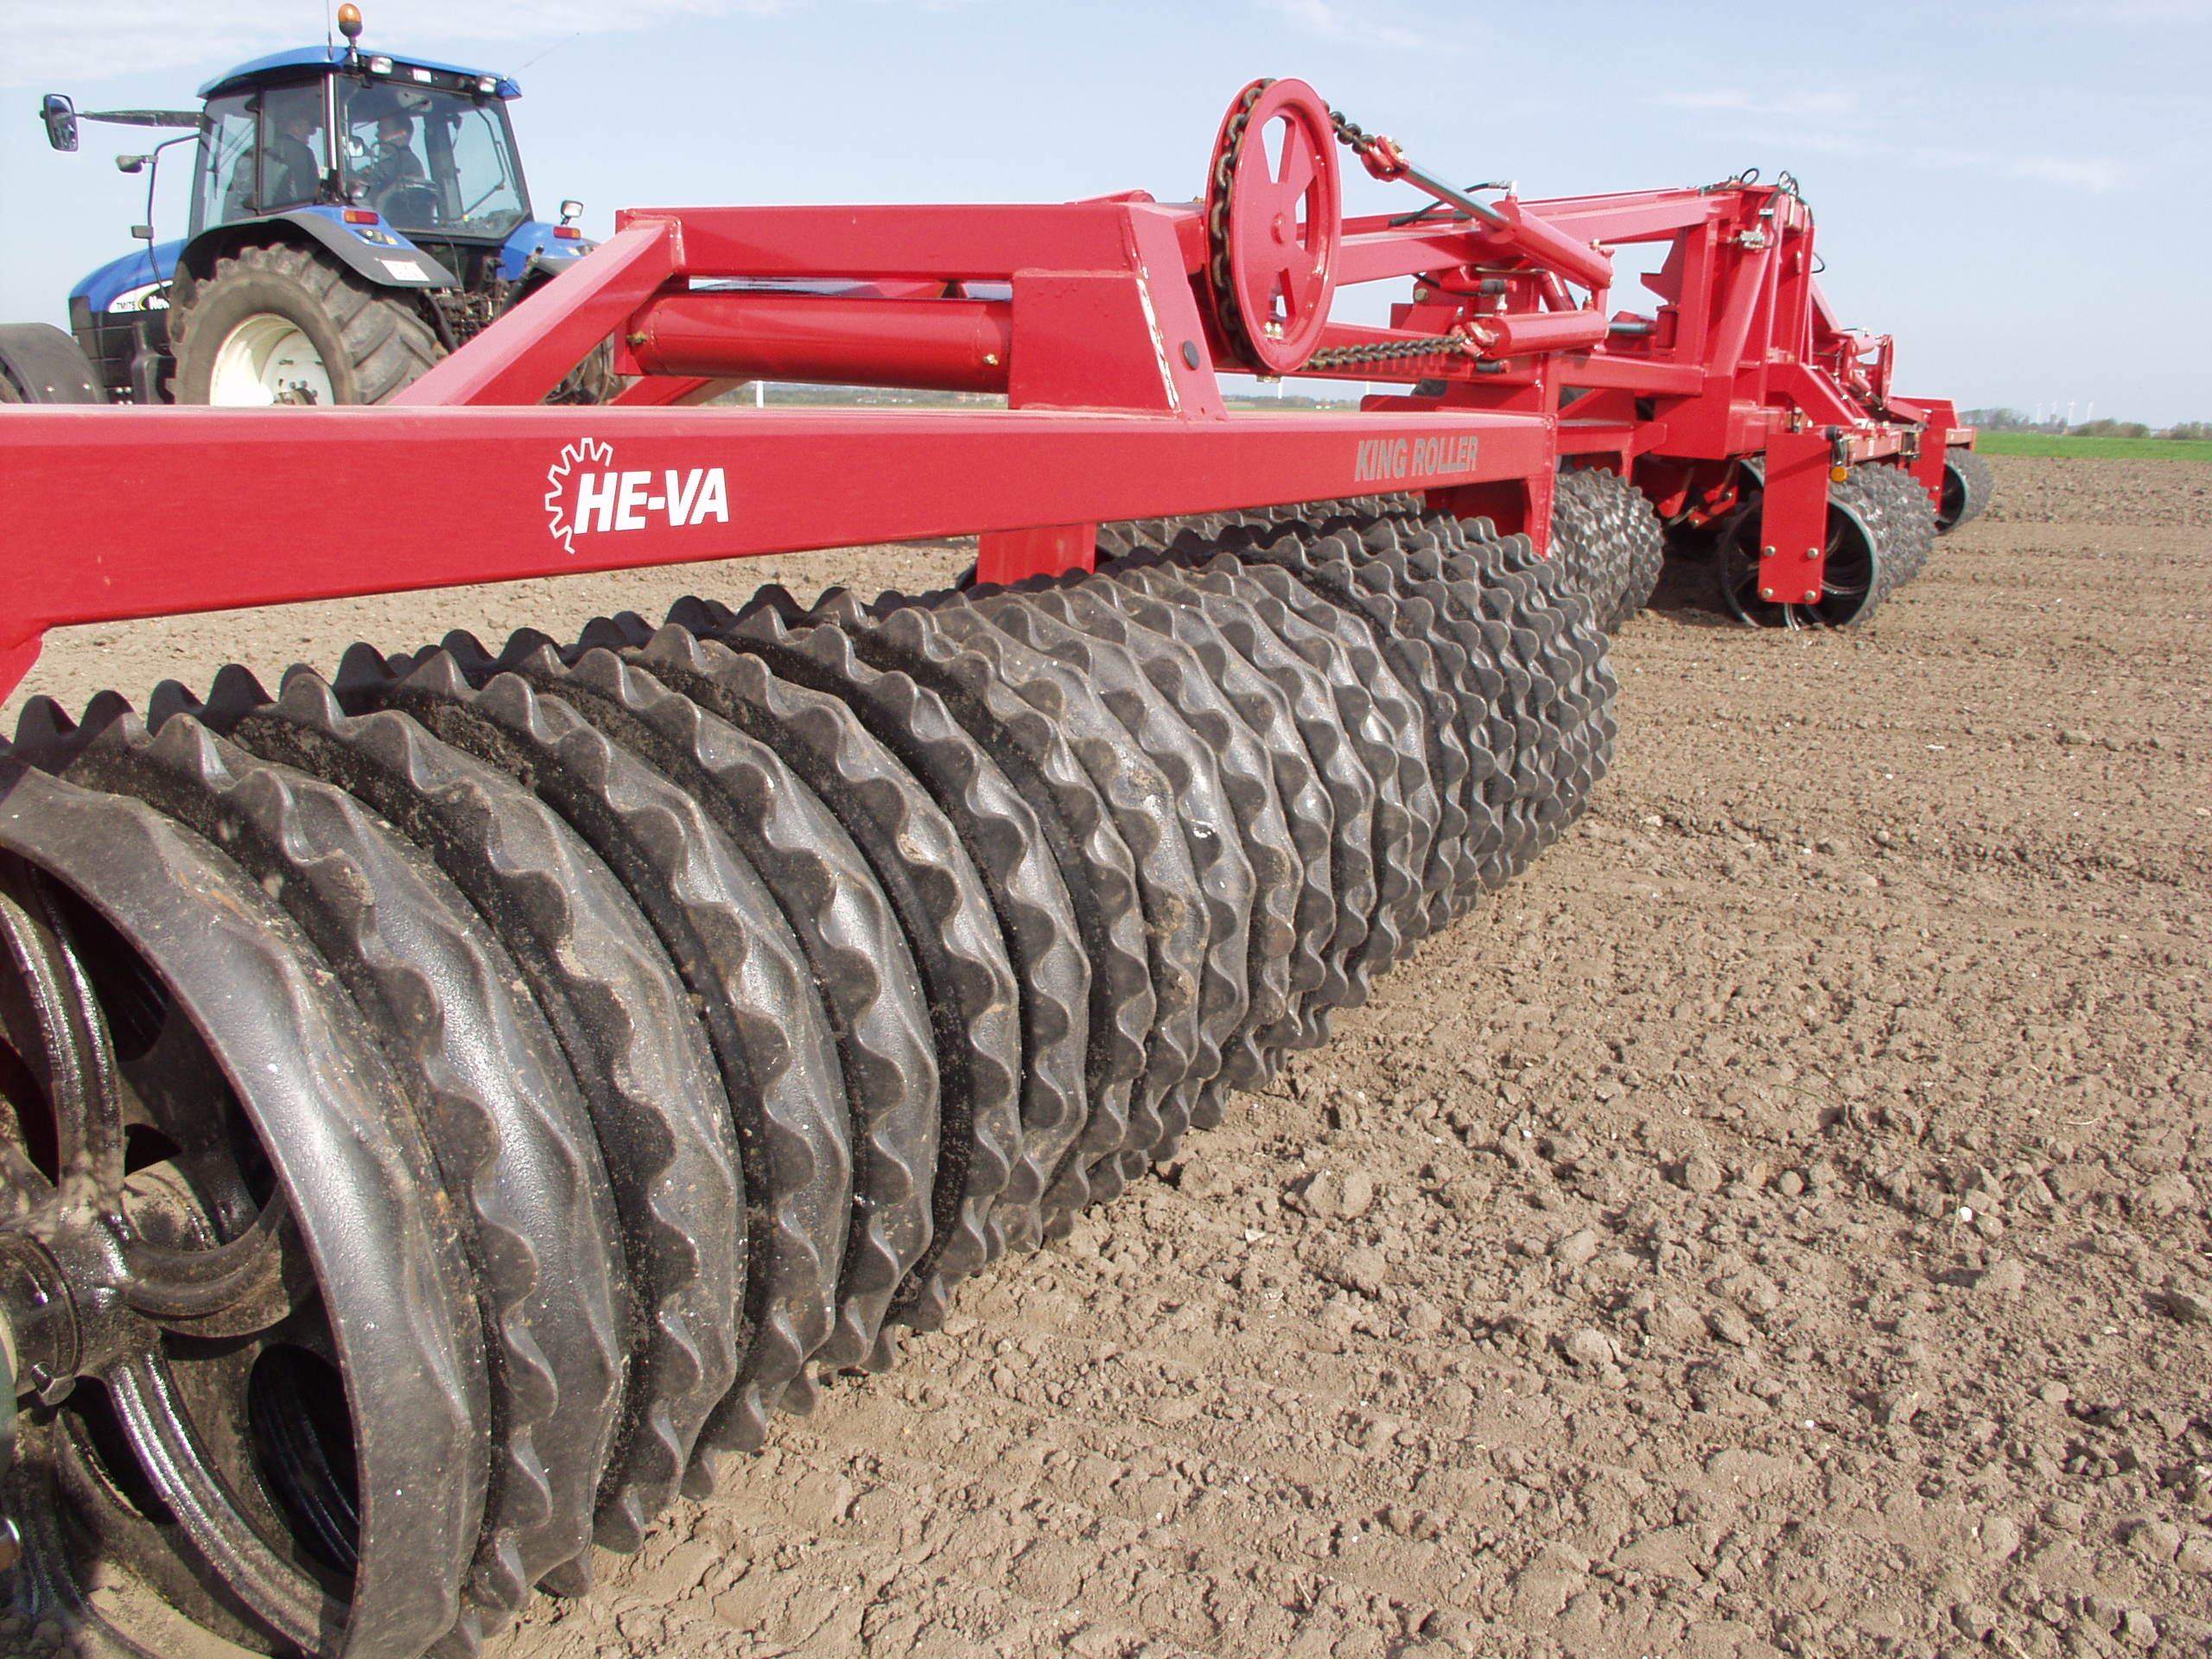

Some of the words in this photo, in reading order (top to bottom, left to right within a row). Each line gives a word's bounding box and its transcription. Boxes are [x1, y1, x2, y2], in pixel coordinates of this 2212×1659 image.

[1354, 438, 1408, 481] KING
[1411, 435, 1478, 477] ROLLER
[573, 467, 729, 534] HE-VA
